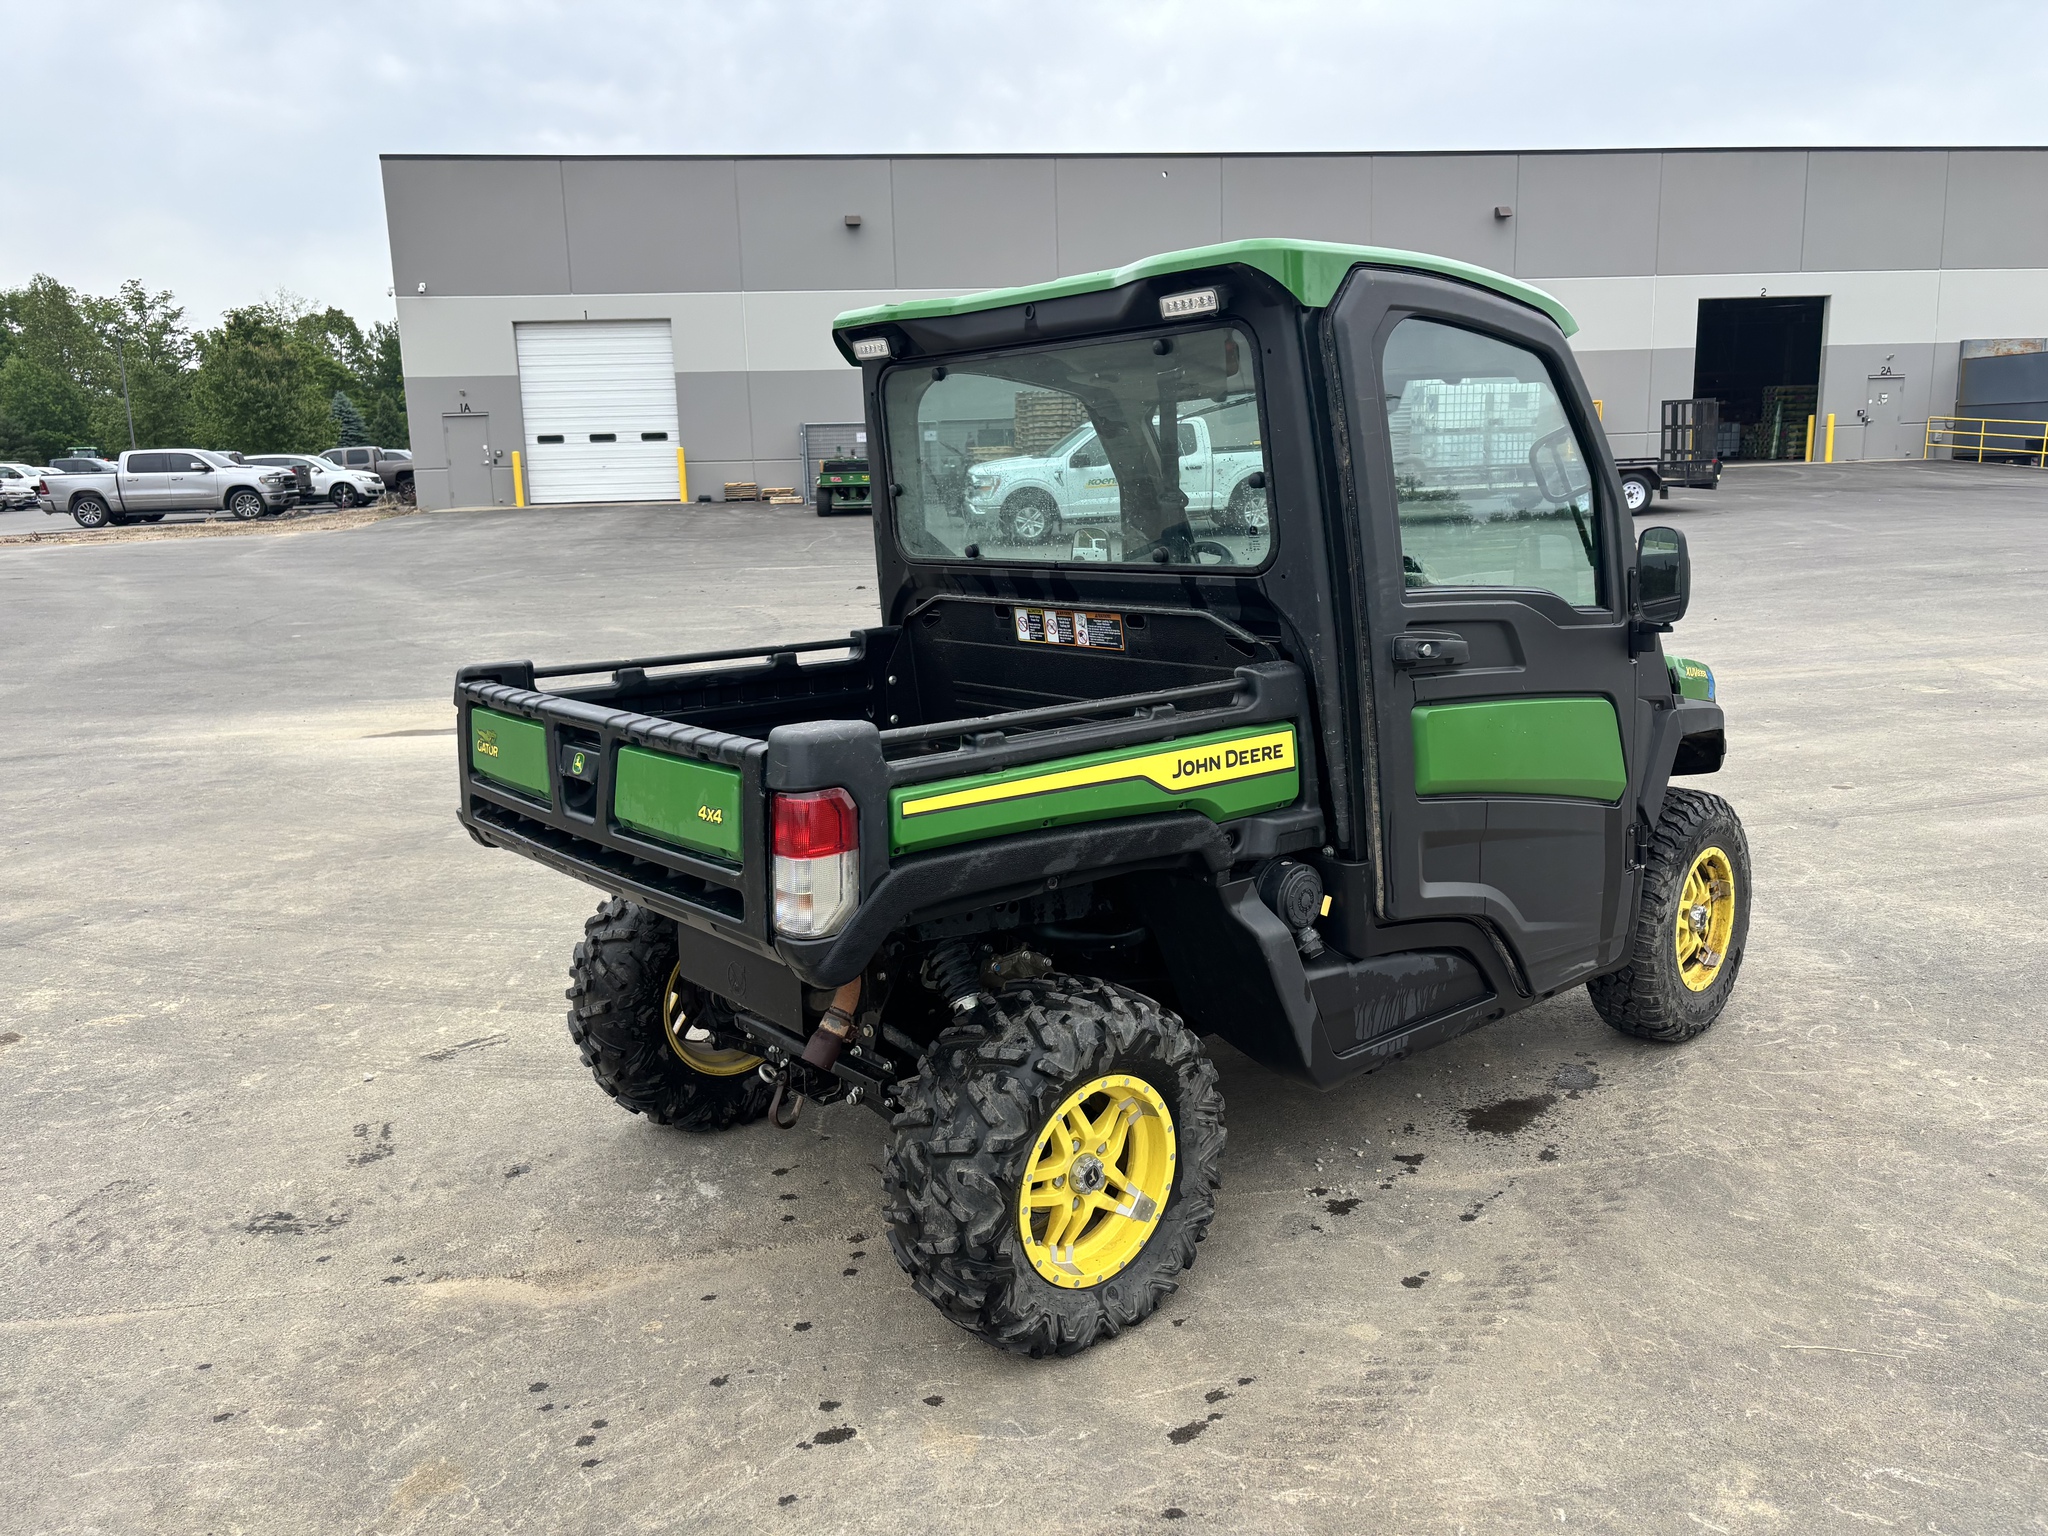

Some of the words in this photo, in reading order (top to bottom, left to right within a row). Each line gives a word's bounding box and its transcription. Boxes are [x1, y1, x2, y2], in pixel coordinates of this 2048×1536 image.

[1760, 287, 1767, 297] 2
[1880, 366, 1892, 376] 2A
[459, 402, 472, 413] 1A
[477, 739, 499, 758] GATOR
[1172, 755, 1221, 779] JOHN
[1225, 743, 1284, 768] DEERE
